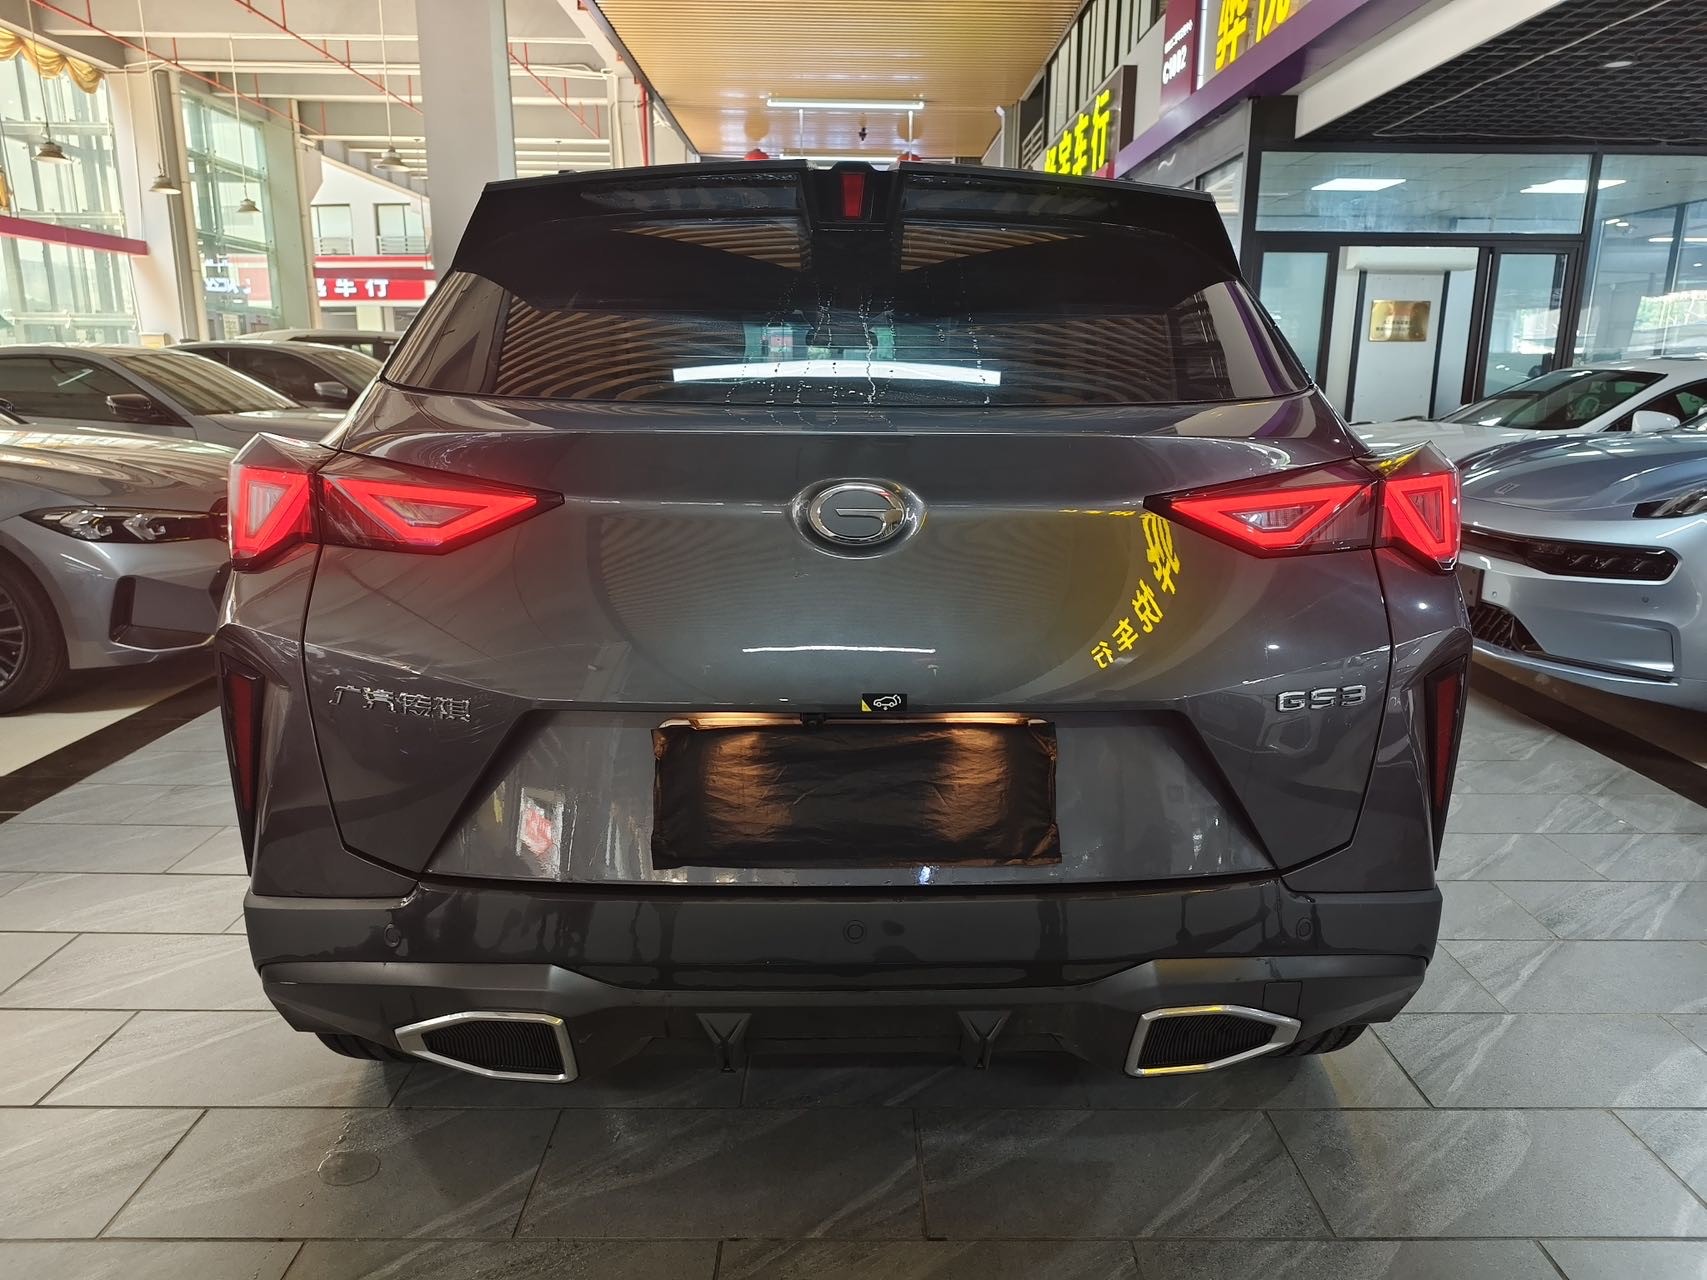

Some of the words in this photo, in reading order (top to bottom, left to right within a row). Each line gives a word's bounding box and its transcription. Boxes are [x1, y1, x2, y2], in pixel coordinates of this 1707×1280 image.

[328, 684, 471, 723] 广汽传祺
[1276, 684, 1367, 712] GS3
